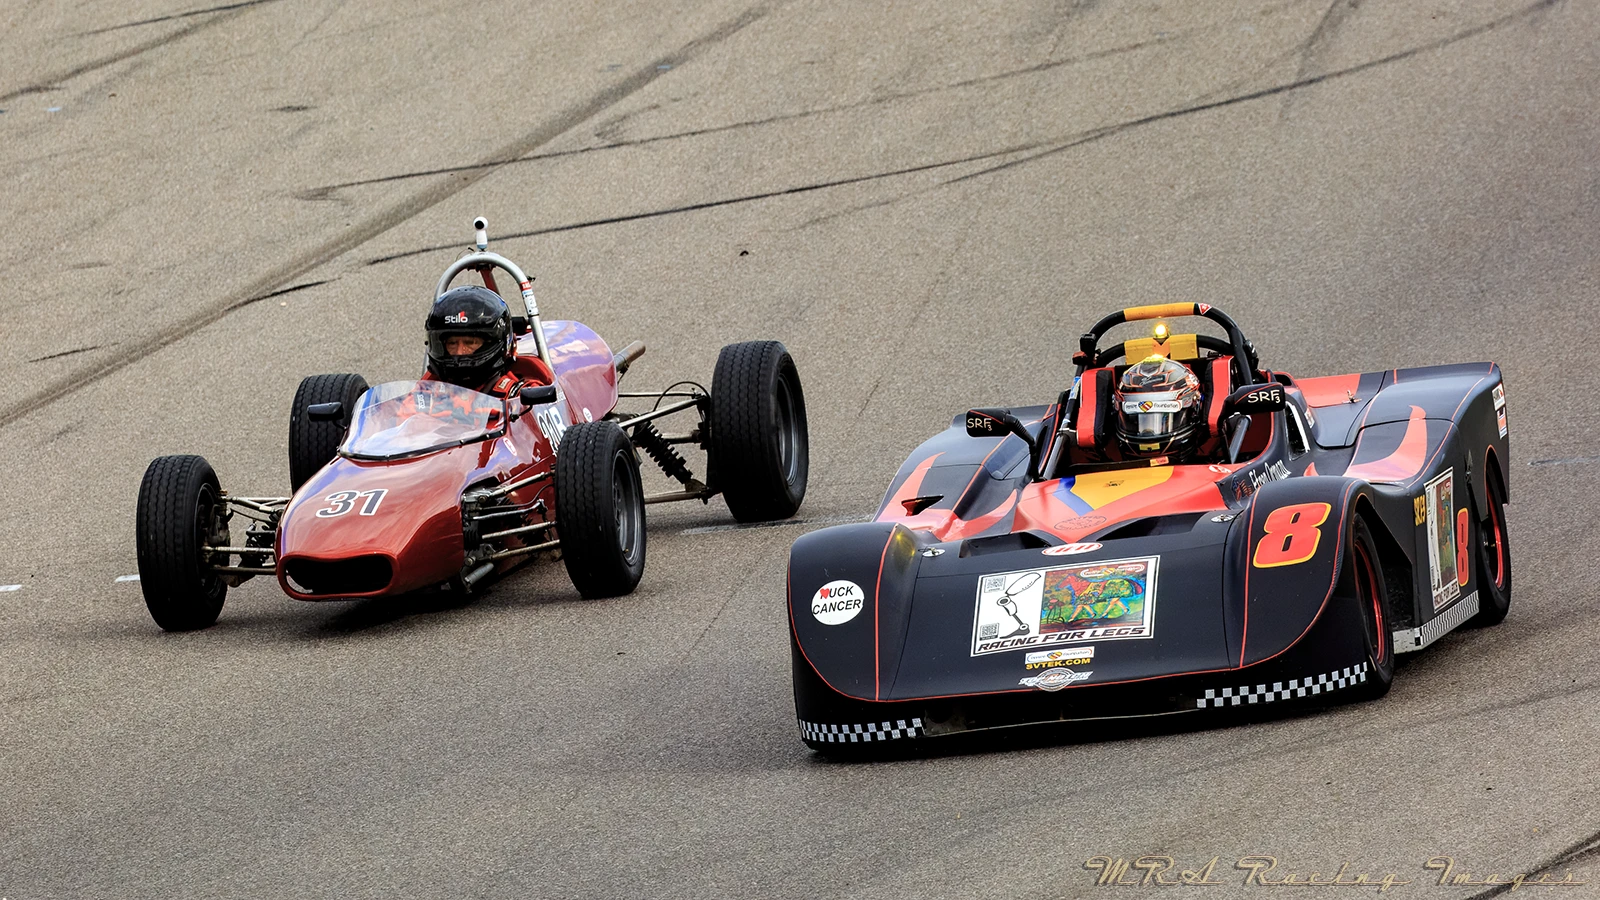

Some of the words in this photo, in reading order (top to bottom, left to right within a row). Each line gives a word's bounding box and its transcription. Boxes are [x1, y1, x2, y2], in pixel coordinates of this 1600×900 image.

[316, 489, 388, 518] 31
[1253, 502, 1331, 568] 8
[1456, 507, 1469, 587] 8
[812, 599, 861, 615] CANCER
[978, 636, 1039, 651] RACING
[1042, 632, 1085, 642] FOR
[1089, 627, 1146, 637] LEGS
[1025, 658, 1091, 670] SVTEK.COM
